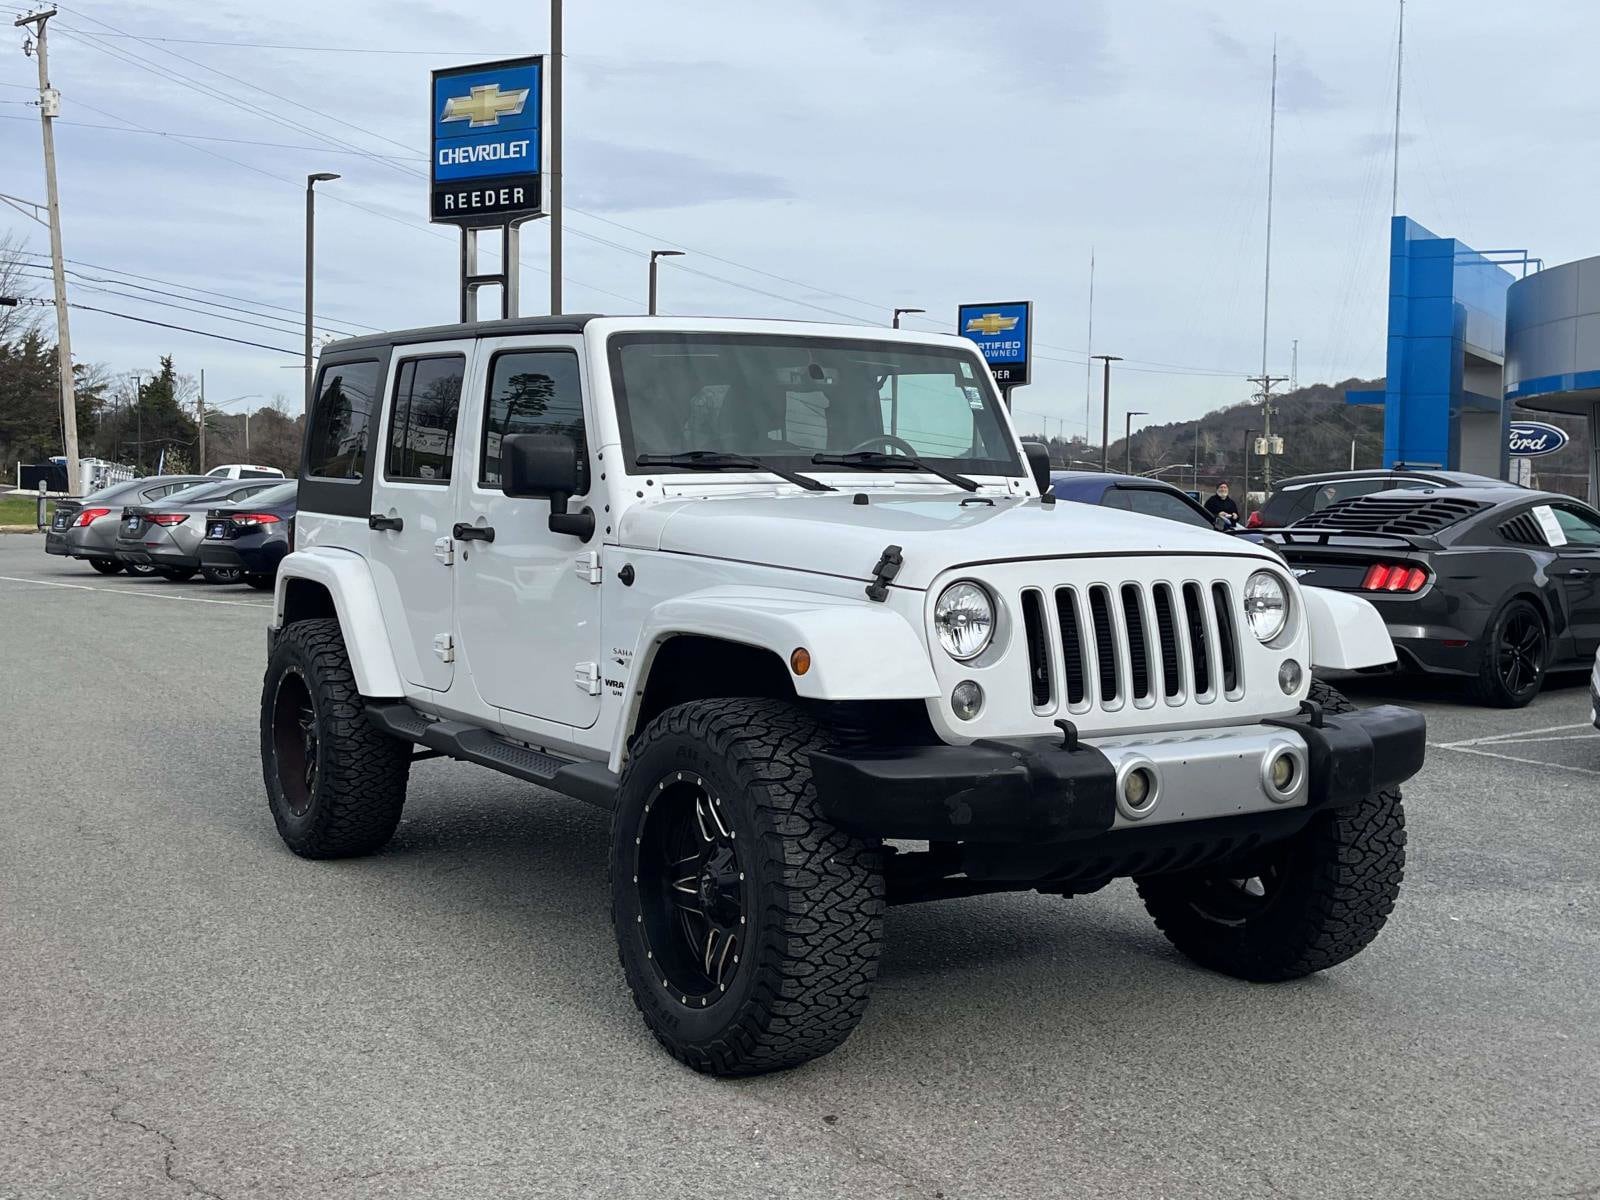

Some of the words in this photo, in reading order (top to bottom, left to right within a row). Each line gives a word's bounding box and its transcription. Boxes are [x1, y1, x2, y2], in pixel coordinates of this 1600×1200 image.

[439, 140, 530, 166] CHEVROLET
[444, 187, 524, 210] REEDER
[977, 341, 1021, 350] RTIFIED
[612, 647, 633, 656] SAHA
